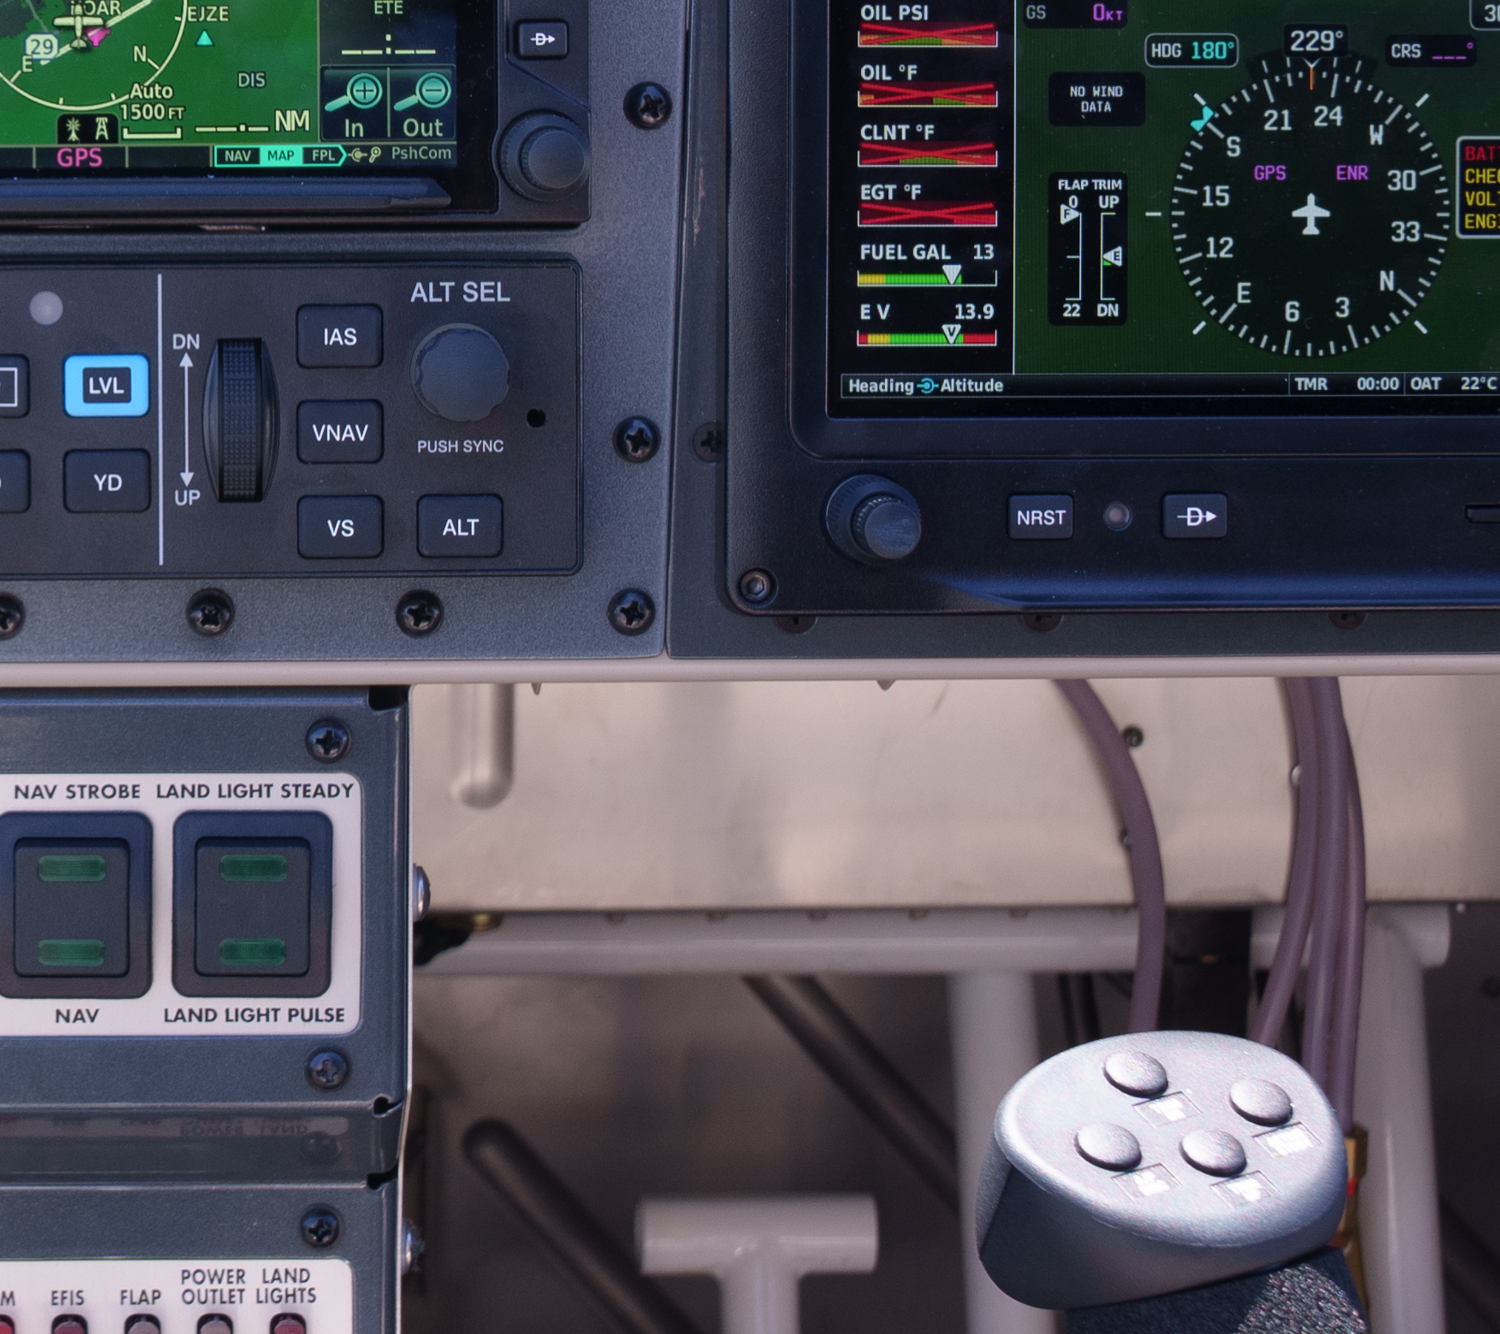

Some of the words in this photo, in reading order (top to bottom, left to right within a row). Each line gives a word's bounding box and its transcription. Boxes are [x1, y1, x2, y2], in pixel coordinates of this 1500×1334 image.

[403, 118, 443, 136] Out
[57, 148, 102, 167] GPS
[411, 282, 455, 302] ALT
[463, 281, 510, 302] SEL
[89, 377, 123, 396] LVL
[312, 424, 369, 443] VNAV
[418, 440, 458, 453] PUSH
[463, 440, 503, 452] SYNC
[1016, 509, 1066, 526] NRST
[15, 785, 57, 799] NAV
[67, 784, 140, 799] STROBE
[156, 783, 209, 799] LAND
[218, 784, 273, 798] LIGHT
[280, 783, 354, 799] STEADY
[121, 1290, 161, 1305] FLAP
